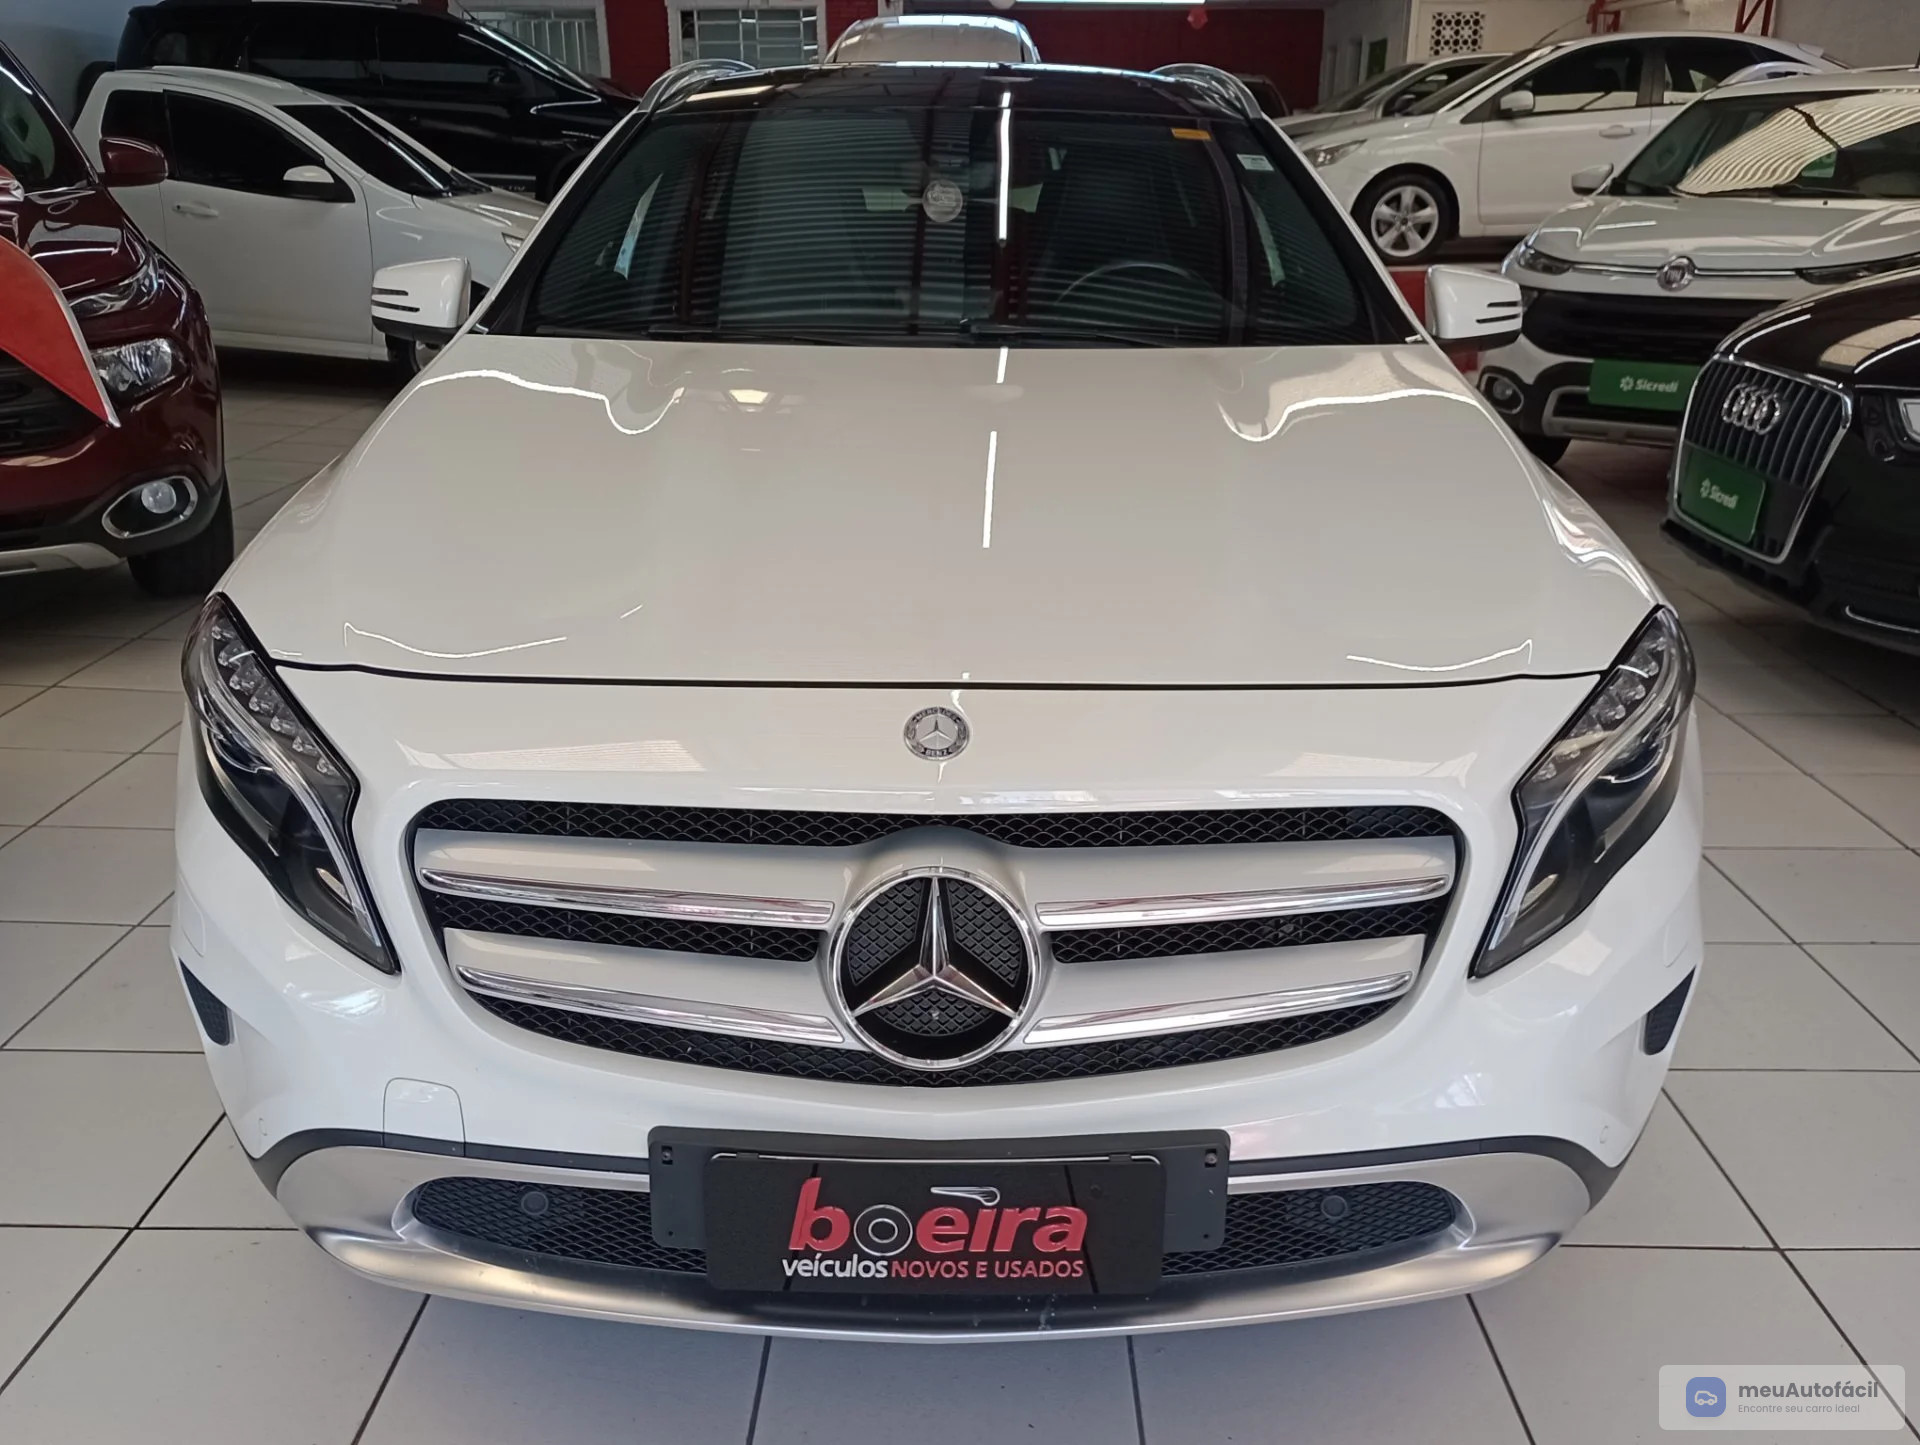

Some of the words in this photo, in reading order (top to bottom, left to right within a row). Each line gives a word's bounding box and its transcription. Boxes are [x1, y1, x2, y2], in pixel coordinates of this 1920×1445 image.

[1635, 377, 1679, 393] Sicredi
[1709, 484, 1739, 510] Sicredi
[788, 1177, 1088, 1256] boeira
[782, 1253, 888, 1278] veículos
[891, 1260, 969, 1278] NOVOS
[975, 1260, 987, 1278] E
[994, 1259, 1084, 1278] USADOS
